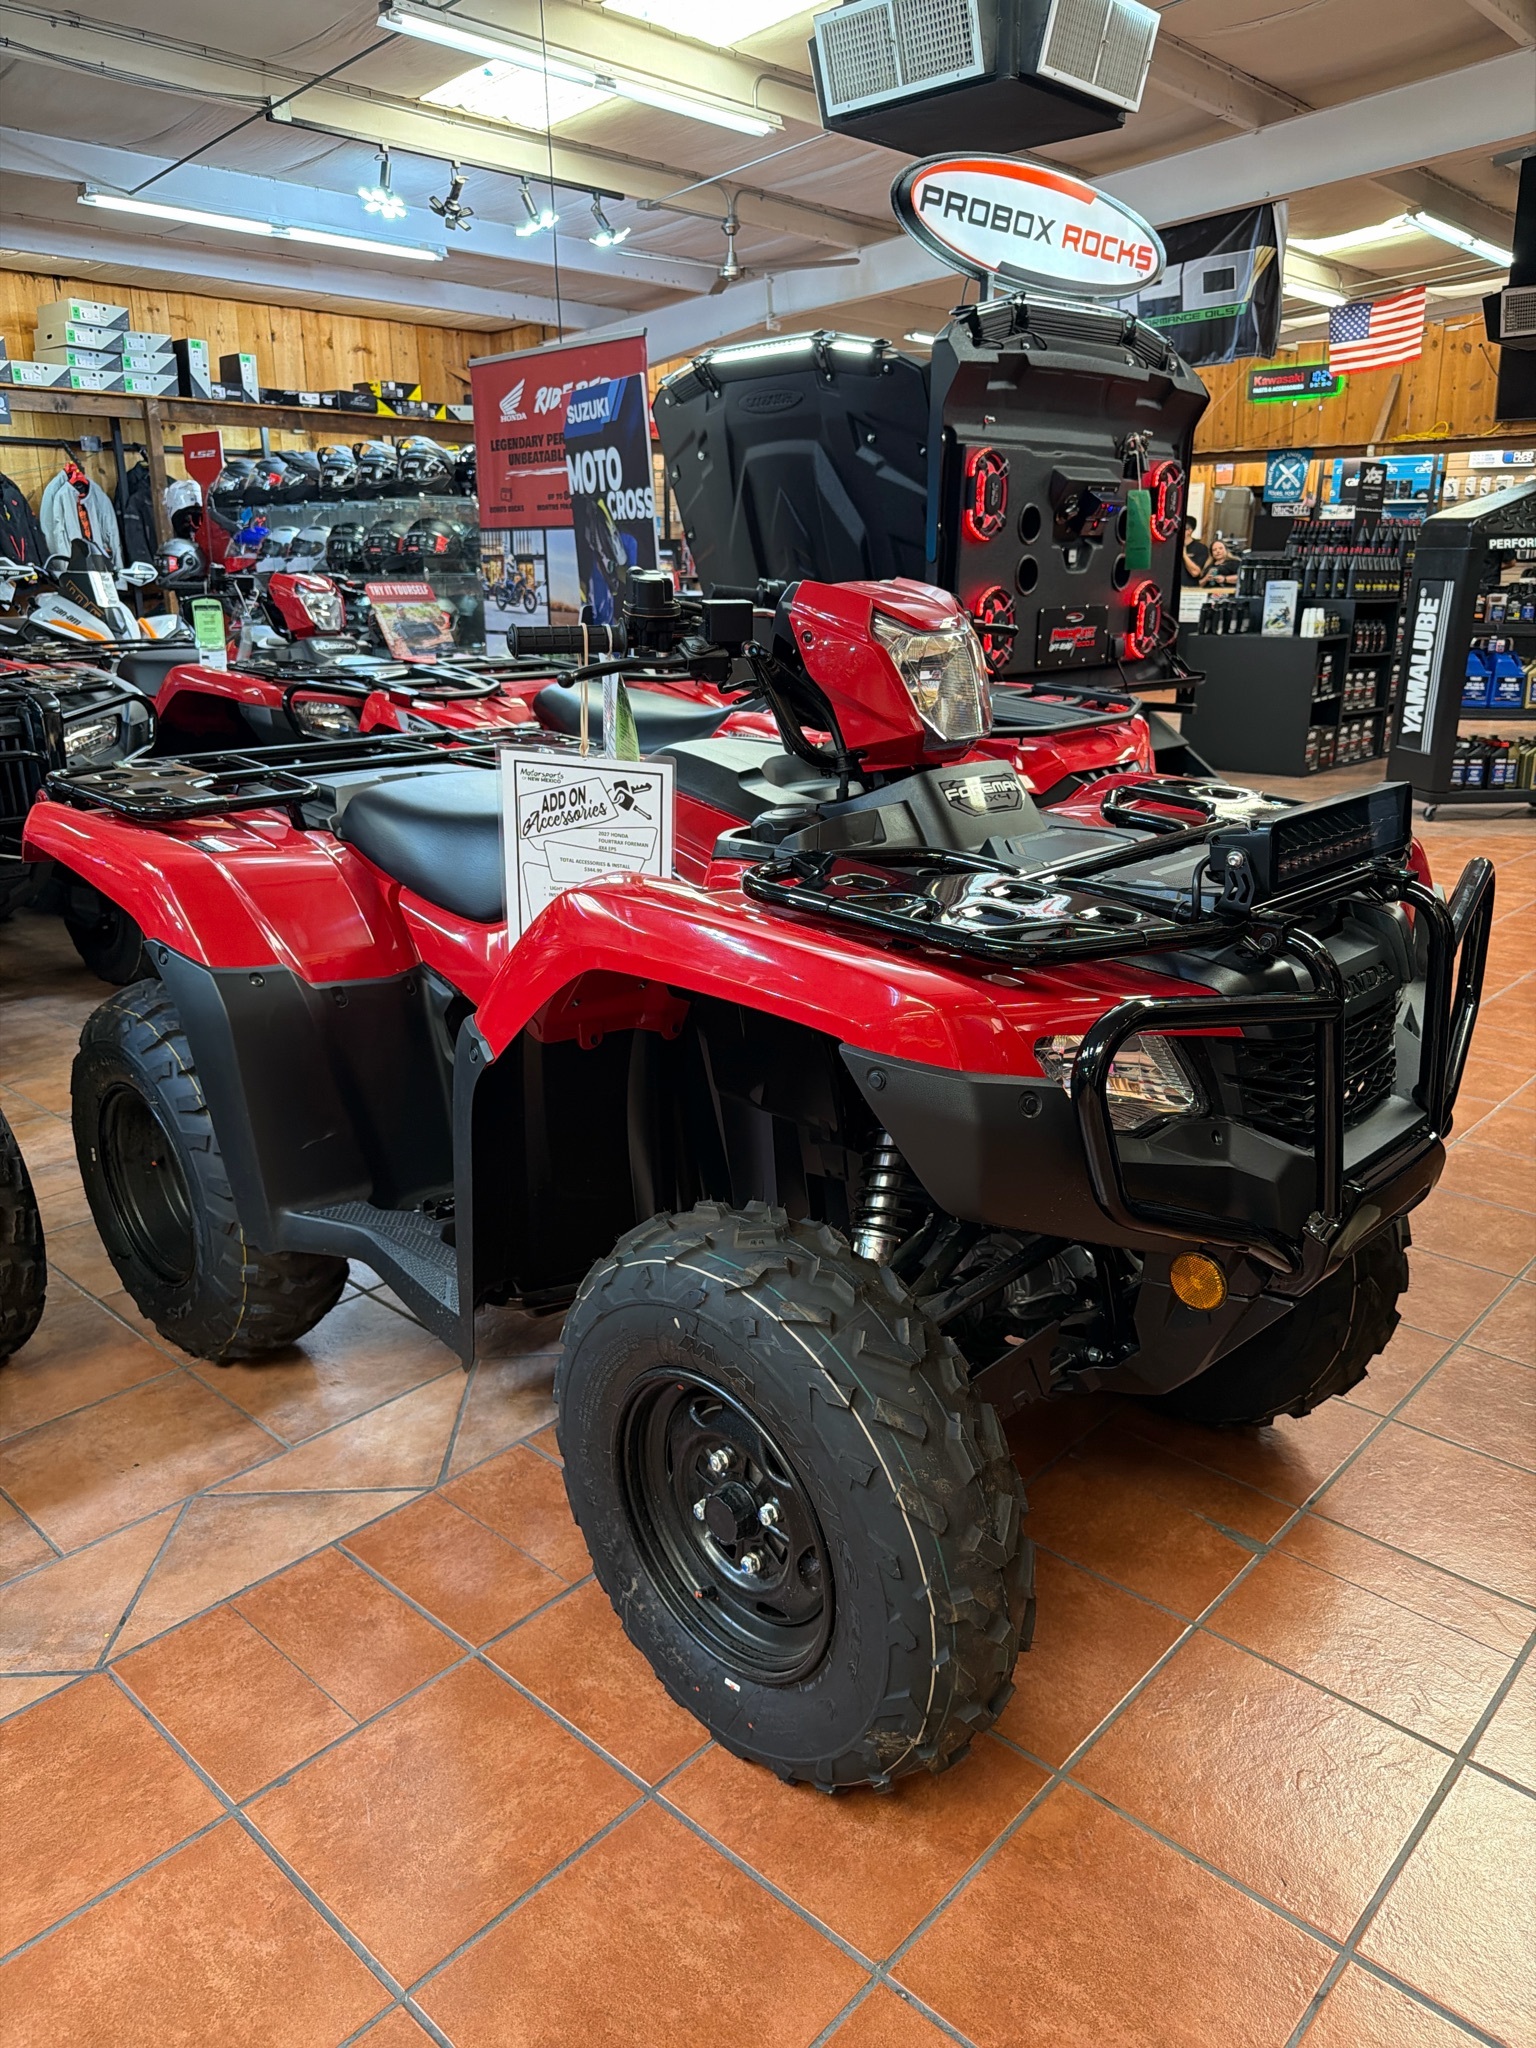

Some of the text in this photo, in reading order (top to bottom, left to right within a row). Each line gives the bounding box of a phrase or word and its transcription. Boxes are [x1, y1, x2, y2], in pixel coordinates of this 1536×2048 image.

[919, 184, 1153, 272] PROBOX ROCKS
[1204, 307, 1235, 319] OILS
[1253, 371, 1305, 387] Kawasaki
[500, 412, 528, 423] HONDA
[567, 396, 610, 425] SUZUKI
[490, 432, 566, 452] LEGENDARY PER
[189, 449, 216, 460] LS2
[566, 446, 623, 496] MOTO
[1362, 466, 1384, 485] XPS
[606, 487, 655, 521] CROSS
[1488, 537, 1536, 550] PERFOR
[368, 585, 385, 596] TRY
[392, 585, 429, 595] YOURSELF
[51, 605, 82, 627] can-am
[520, 768, 565, 780] Motorsports
[541, 785, 587, 815] ADD ON
[522, 799, 608, 837] Accessories
[598, 838, 649, 849] FOURTRAX FOREMAN
[610, 832, 629, 840] HONDA
[560, 856, 575, 864] TOTAL
[575, 858, 607, 867] ACCESSORIES
[612, 862, 631, 870] INSTALL
